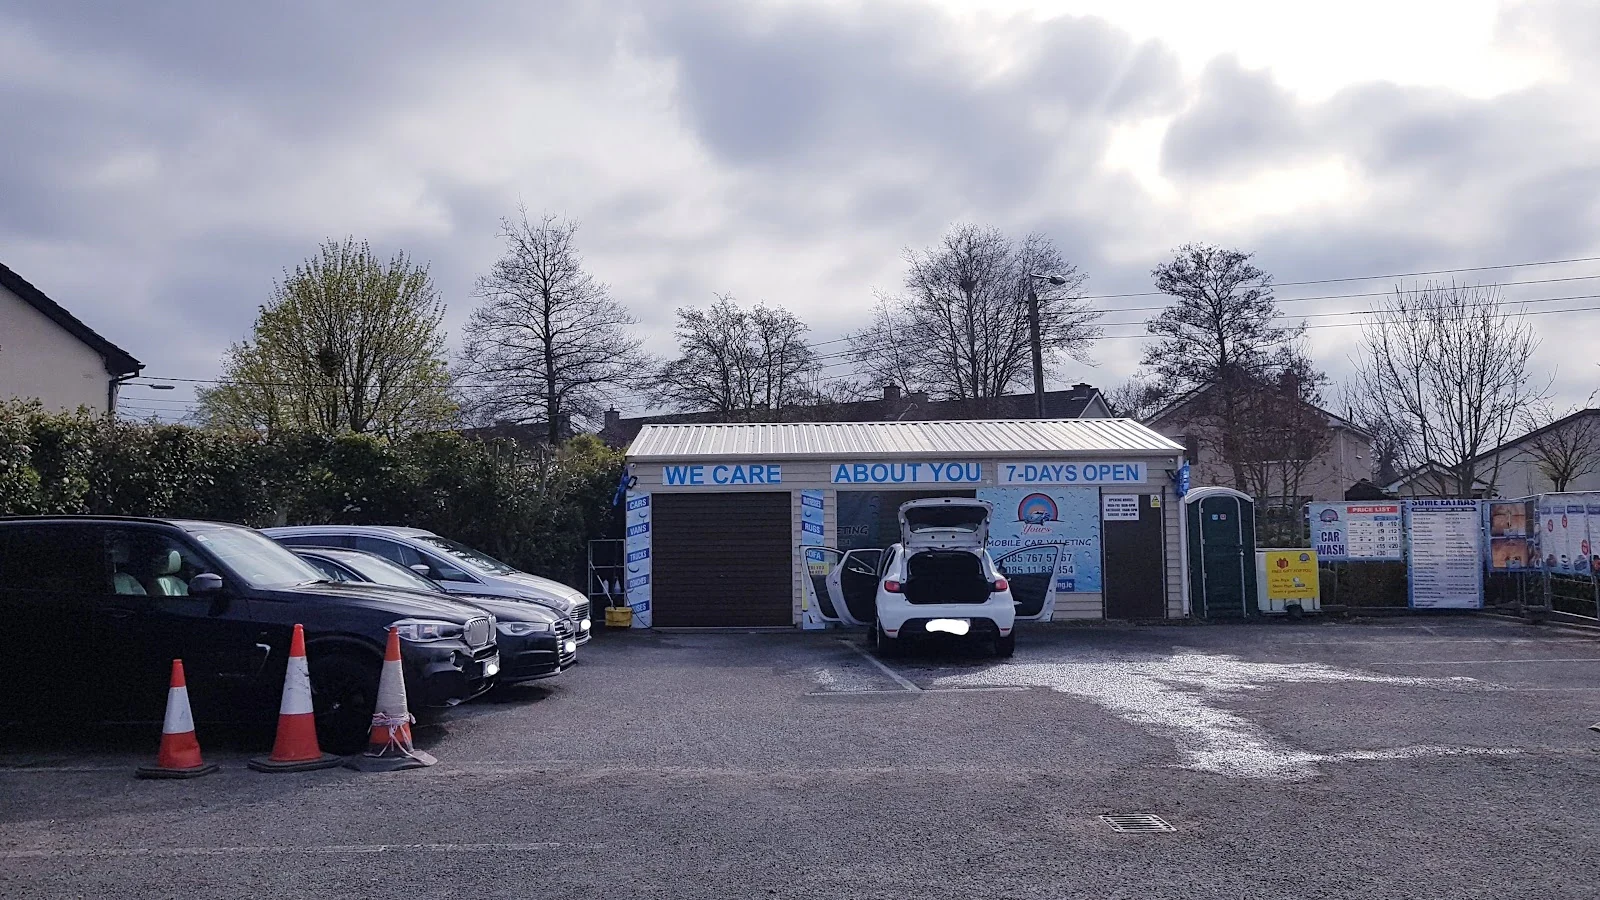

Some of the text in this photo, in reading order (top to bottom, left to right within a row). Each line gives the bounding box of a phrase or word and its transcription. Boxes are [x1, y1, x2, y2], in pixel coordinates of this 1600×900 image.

[665, 464, 781, 485] WE CARE
[834, 462, 981, 483] ABOUT YOU
[1005, 464, 1139, 482] 7-DAYS OPEN
[630, 498, 647, 510] CARS
[630, 524, 647, 536] VANS
[804, 523, 821, 534] RUGS
[1022, 524, 1052, 535] Yours
[1321, 531, 1340, 542] CAR
[986, 539, 1021, 547] MOBILE
[1024, 539, 1043, 547] CAR
[806, 549, 822, 560] SOFA
[1316, 544, 1345, 555] WASH
[630, 550, 647, 562] TRUCKS
[1005, 553, 1023, 563] 085
[1026, 553, 1043, 563] 767
